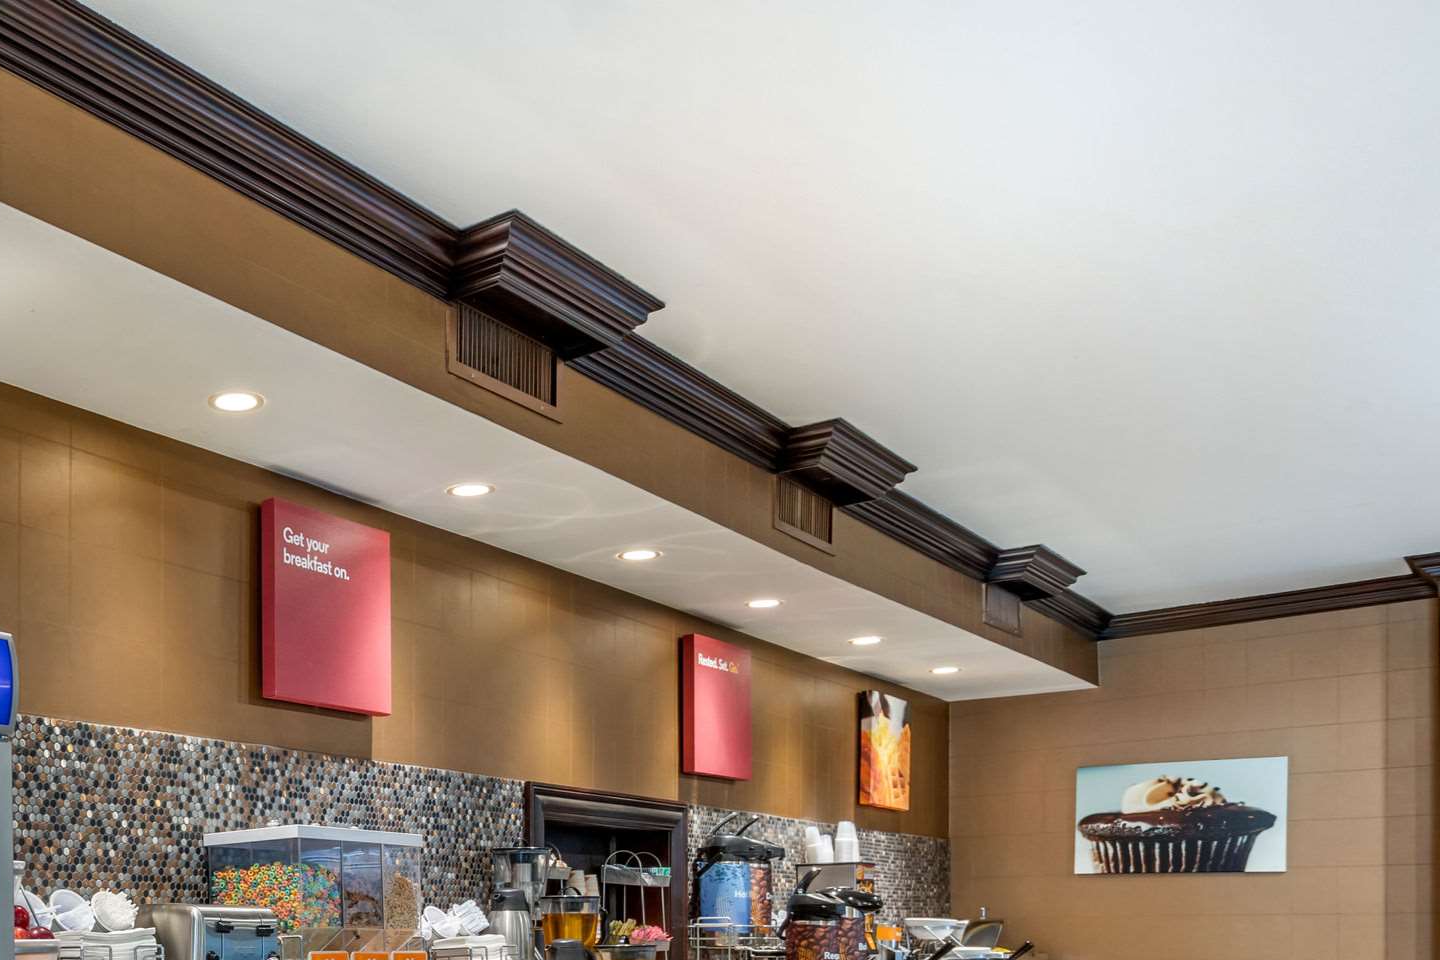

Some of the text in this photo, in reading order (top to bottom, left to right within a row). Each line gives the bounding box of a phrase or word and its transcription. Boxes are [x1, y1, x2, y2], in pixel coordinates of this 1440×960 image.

[283, 527, 330, 554] Get your
[283, 547, 350, 581] breakfast on.
